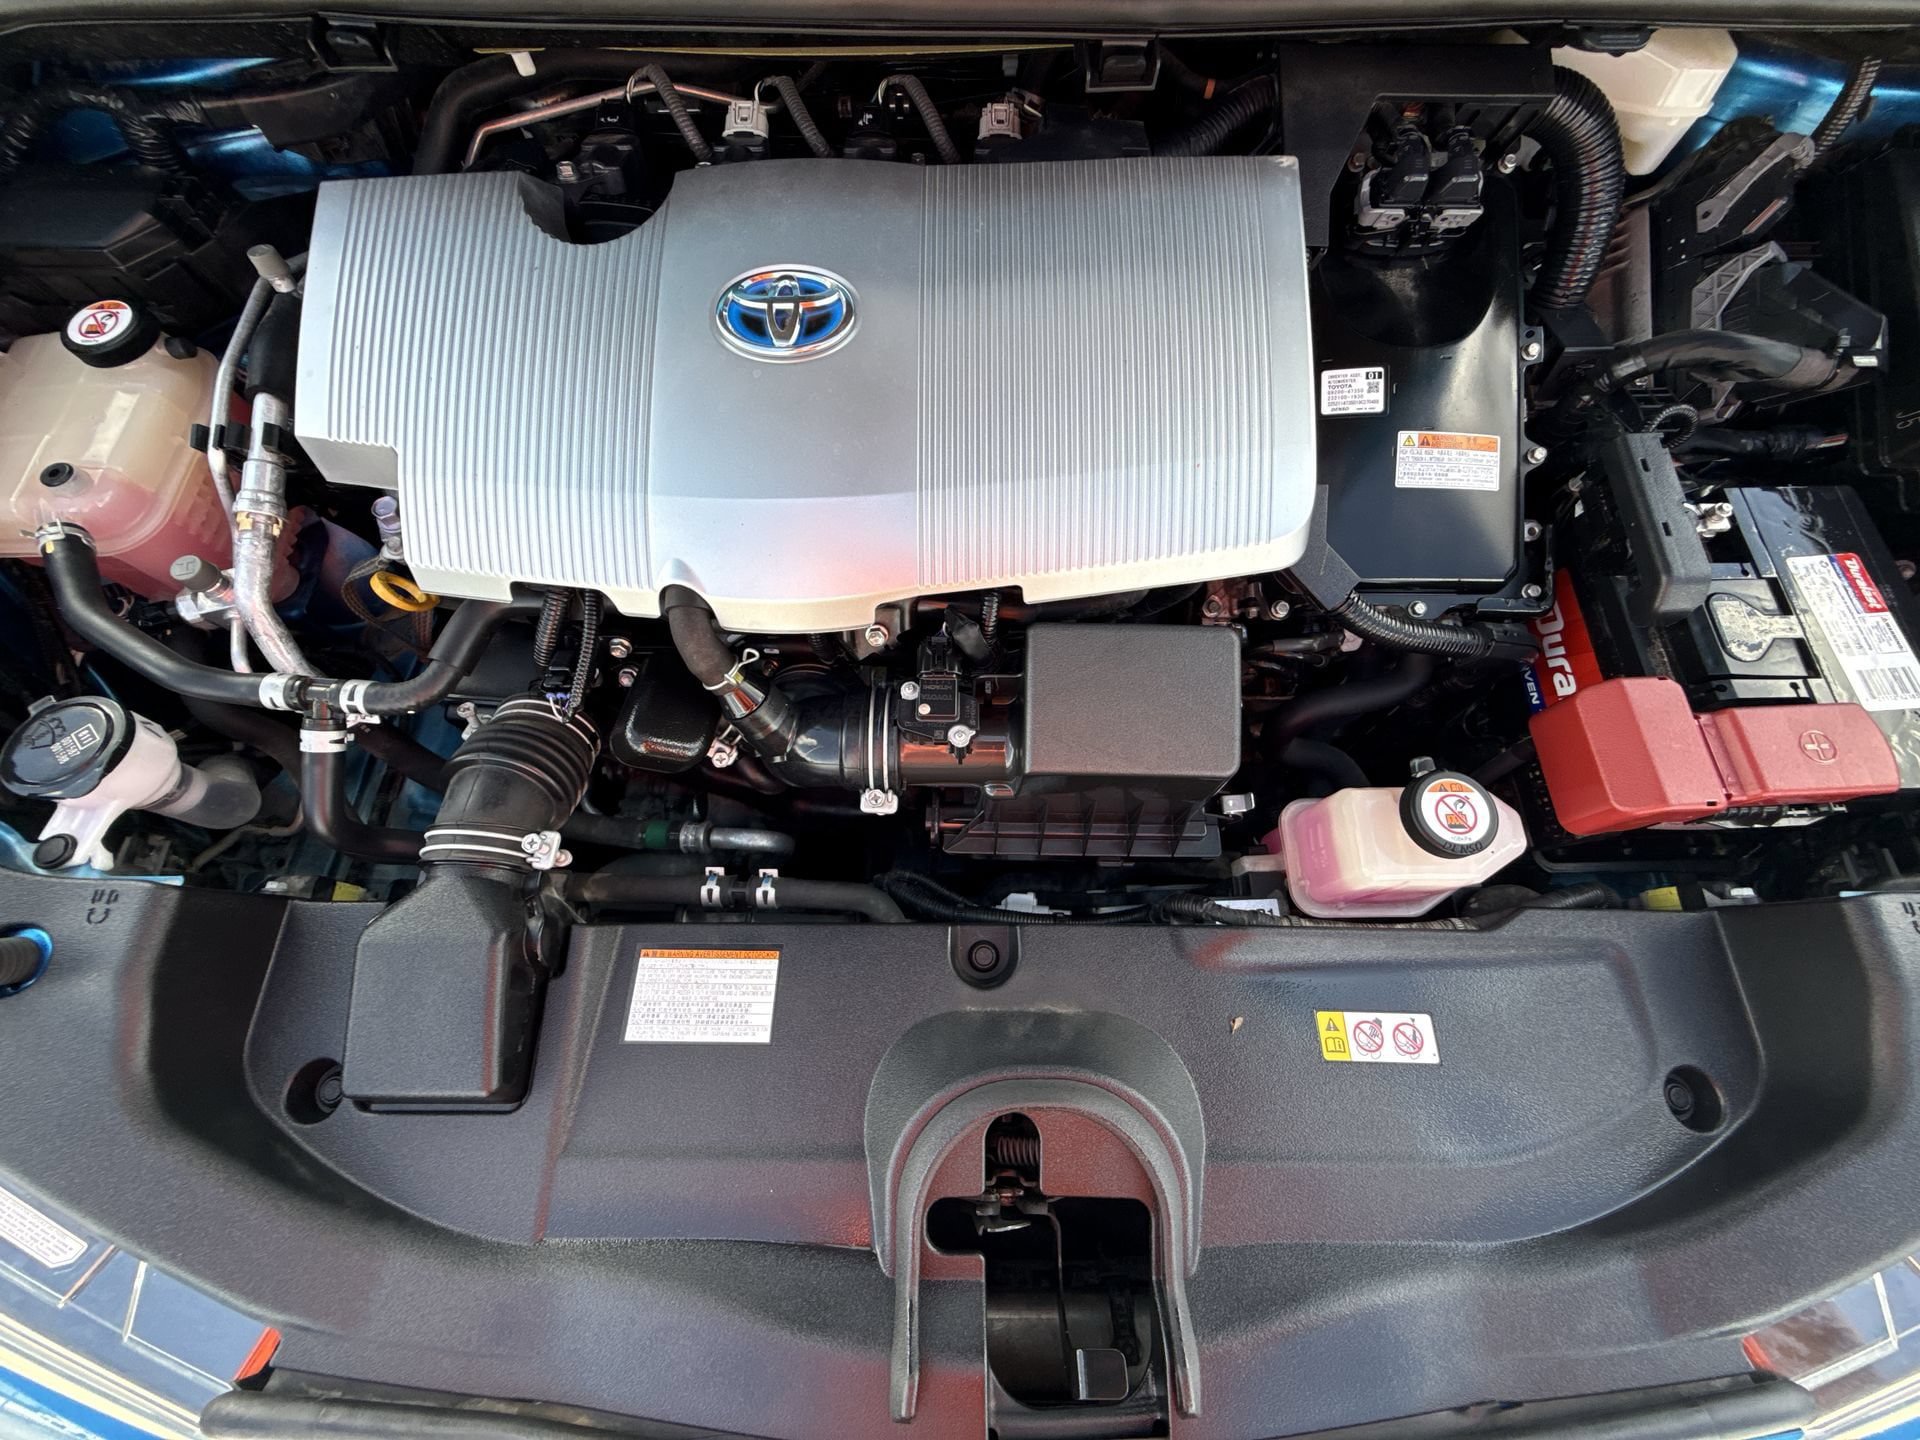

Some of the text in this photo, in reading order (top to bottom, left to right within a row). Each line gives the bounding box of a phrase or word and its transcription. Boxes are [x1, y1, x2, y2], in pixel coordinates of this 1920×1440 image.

[1844, 557, 1882, 610] Duralast
[1535, 600, 1577, 699] Dura
[1521, 666, 1541, 705] VEN
[1442, 841, 1484, 854] DENSO
